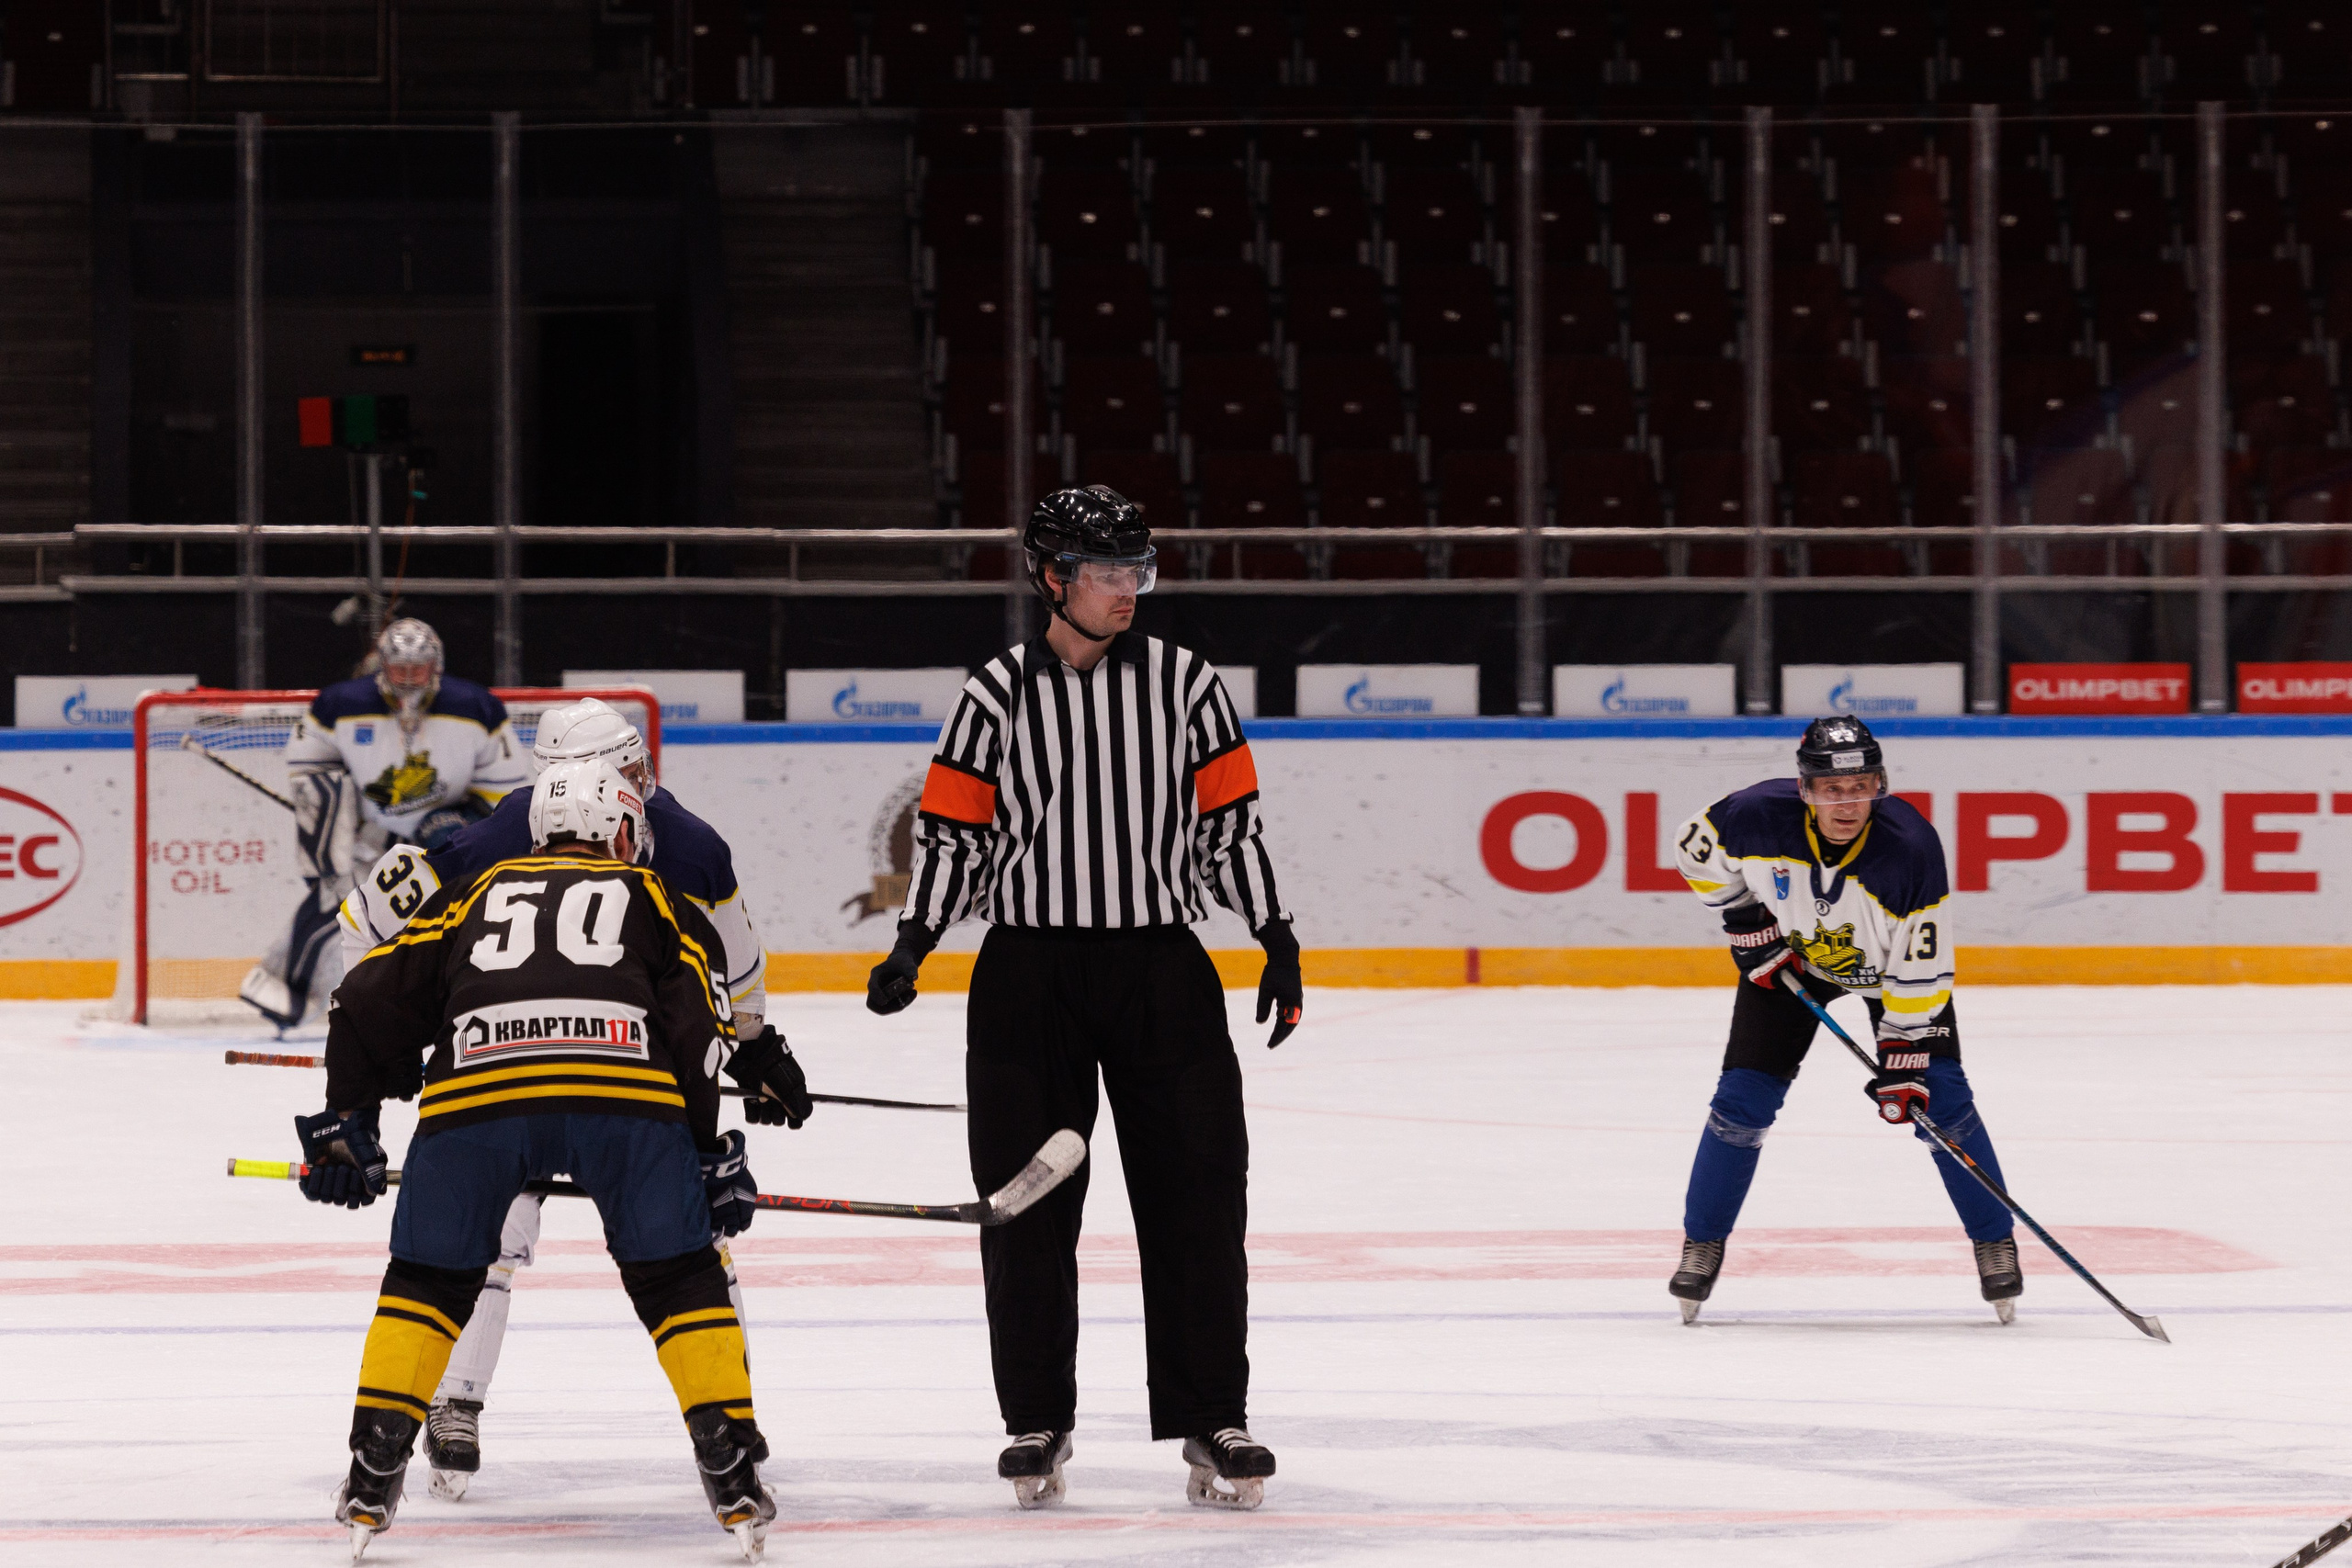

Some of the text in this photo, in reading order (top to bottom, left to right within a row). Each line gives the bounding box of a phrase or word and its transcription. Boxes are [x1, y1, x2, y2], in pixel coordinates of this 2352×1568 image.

[2015, 678, 2184, 701] OLIMPBET
[2243, 679, 2352, 700] OLIMP
[599, 742, 628, 756] BAUER
[550, 780, 567, 798] 15
[619, 794, 642, 816] FONBET
[1479, 790, 2352, 895] OLPBE
[1679, 823, 1713, 864] 13
[171, 869, 232, 895] OIL
[376, 854, 424, 920] 33
[469, 878, 631, 972] 50
[1730, 924, 1781, 947] WARRI
[1904, 921, 1939, 961] 13
[495, 1017, 641, 1044] КВАРТАЛ17А
[1885, 1053, 1929, 1070] WAR
[312, 1122, 341, 1138] CCM
